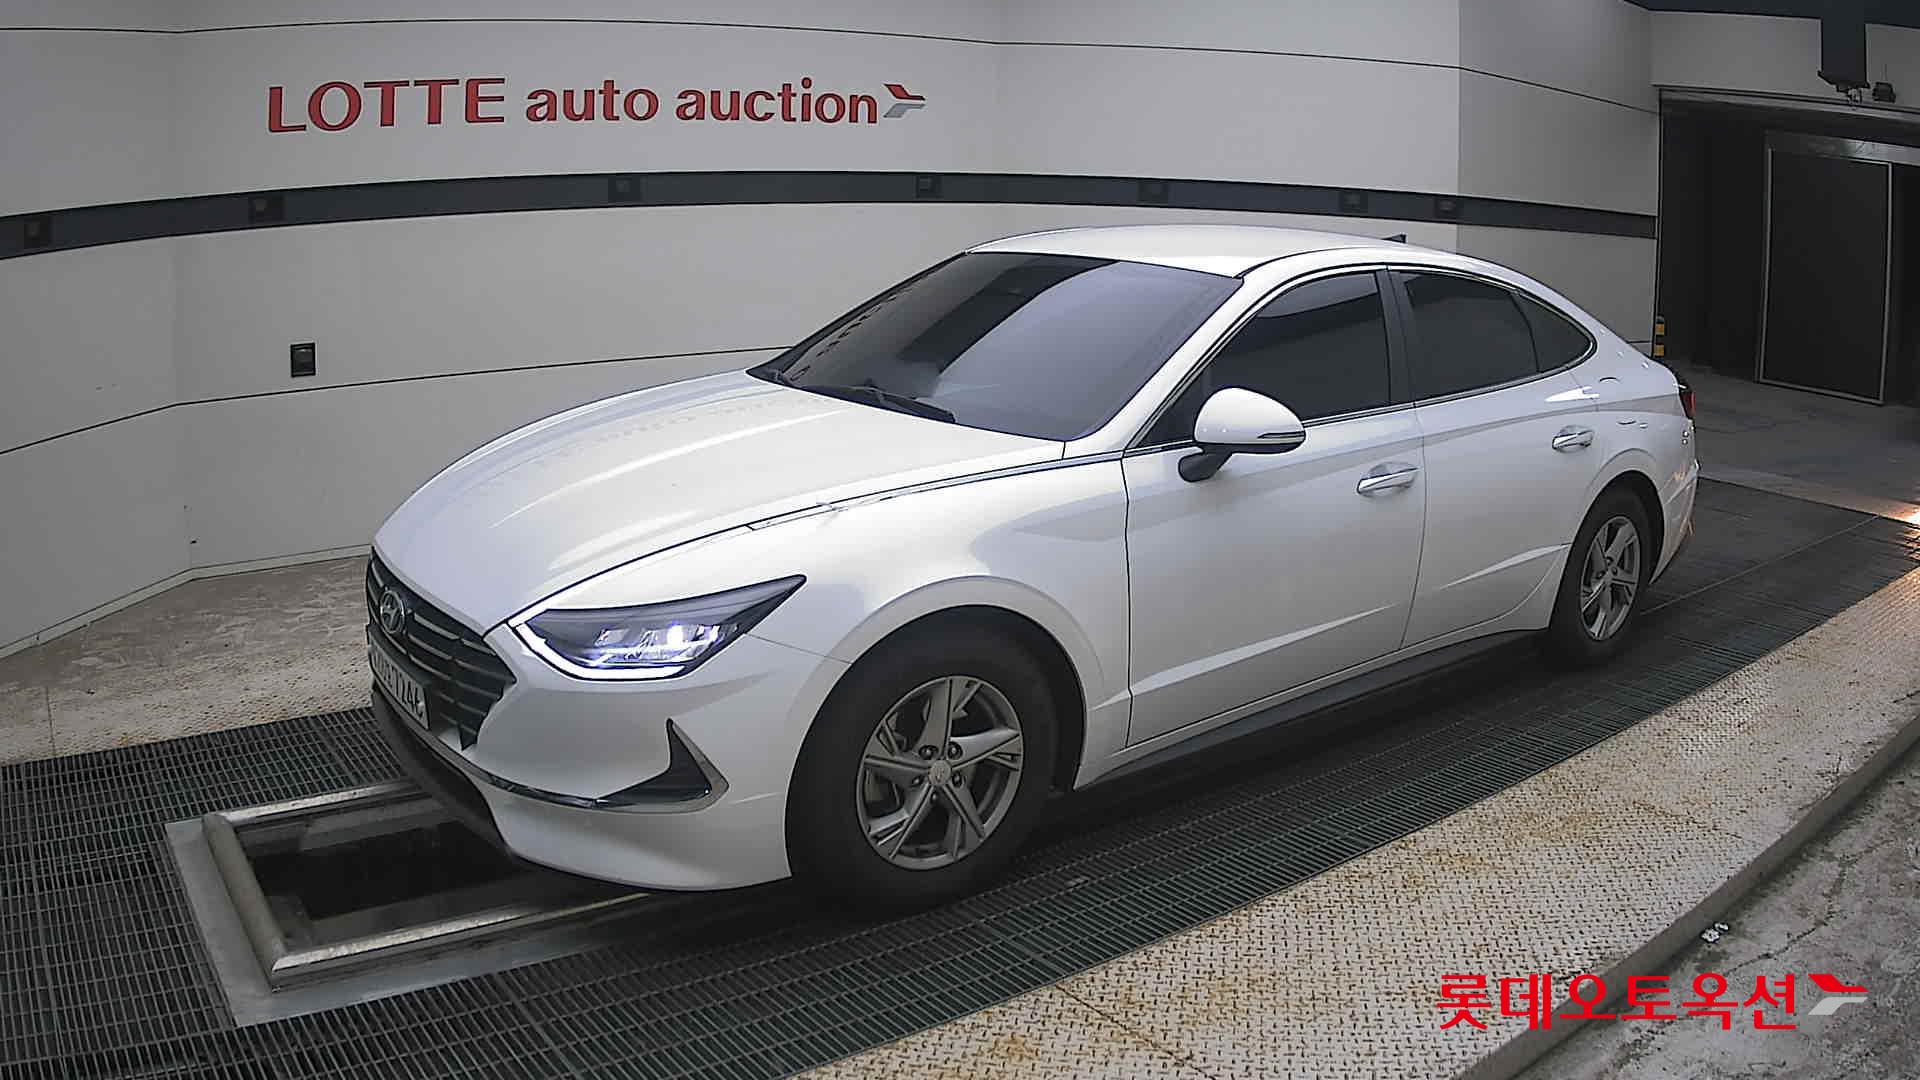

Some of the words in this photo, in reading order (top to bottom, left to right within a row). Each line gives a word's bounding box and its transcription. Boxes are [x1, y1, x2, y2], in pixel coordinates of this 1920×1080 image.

[268, 78, 505, 133] LOTTE
[526, 79, 659, 122] auto
[675, 77, 878, 124] auction
